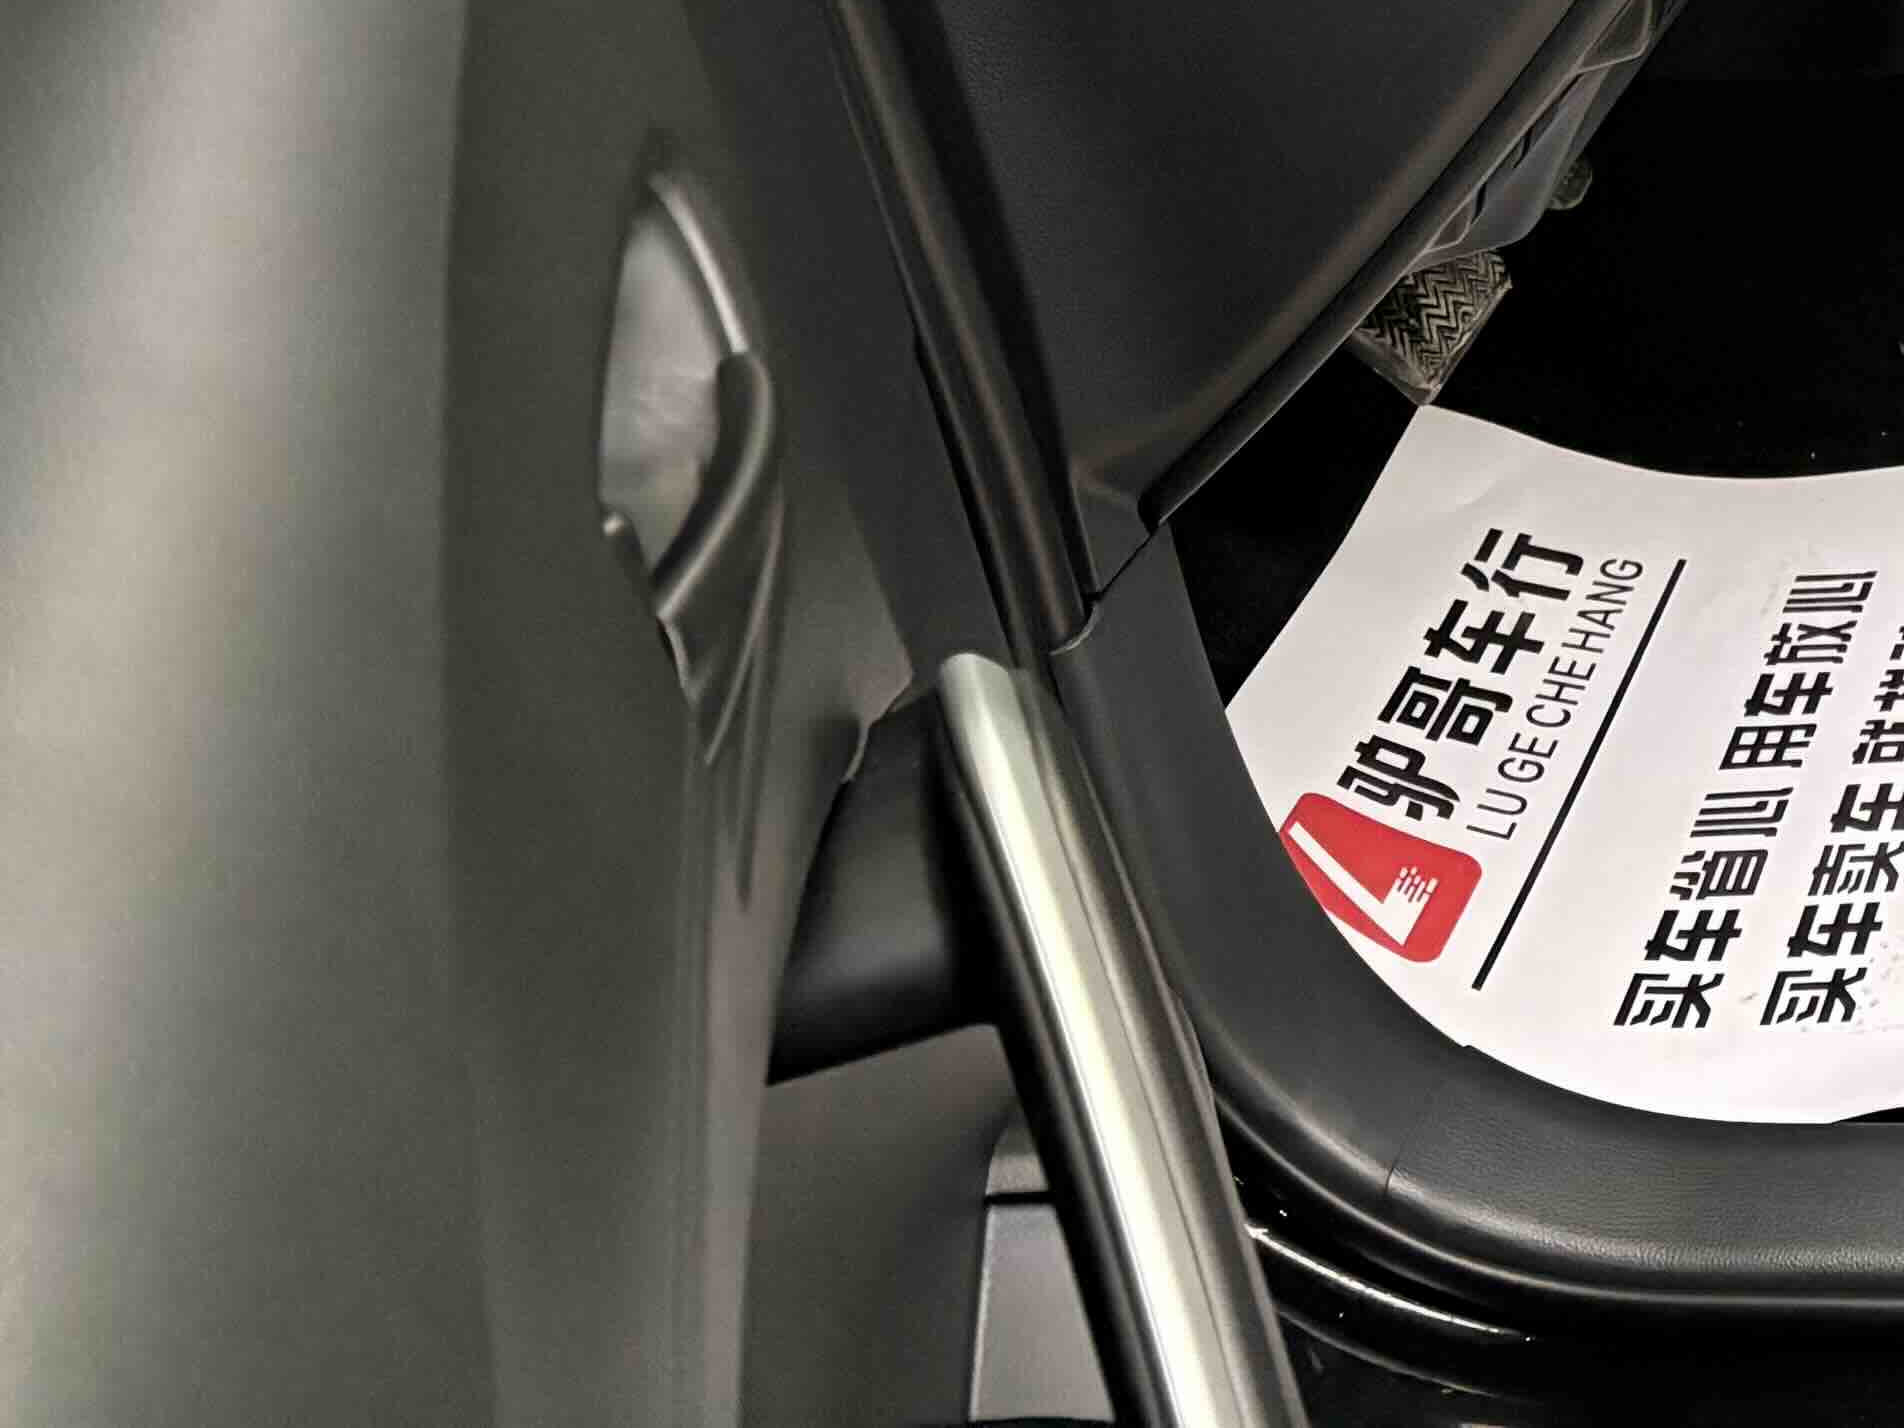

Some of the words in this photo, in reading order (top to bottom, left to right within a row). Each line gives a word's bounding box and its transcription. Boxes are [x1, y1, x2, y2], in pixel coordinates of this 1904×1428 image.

[1560, 557, 1644, 654] HANG
[1337, 528, 1585, 821] 驴哥车行
[1526, 656, 1596, 729] CHE
[1498, 732, 1559, 785] GE
[1613, 785, 1795, 1028] 买车省心
[1718, 570, 1878, 770] 用车放心
[1466, 788, 1529, 841] LU
